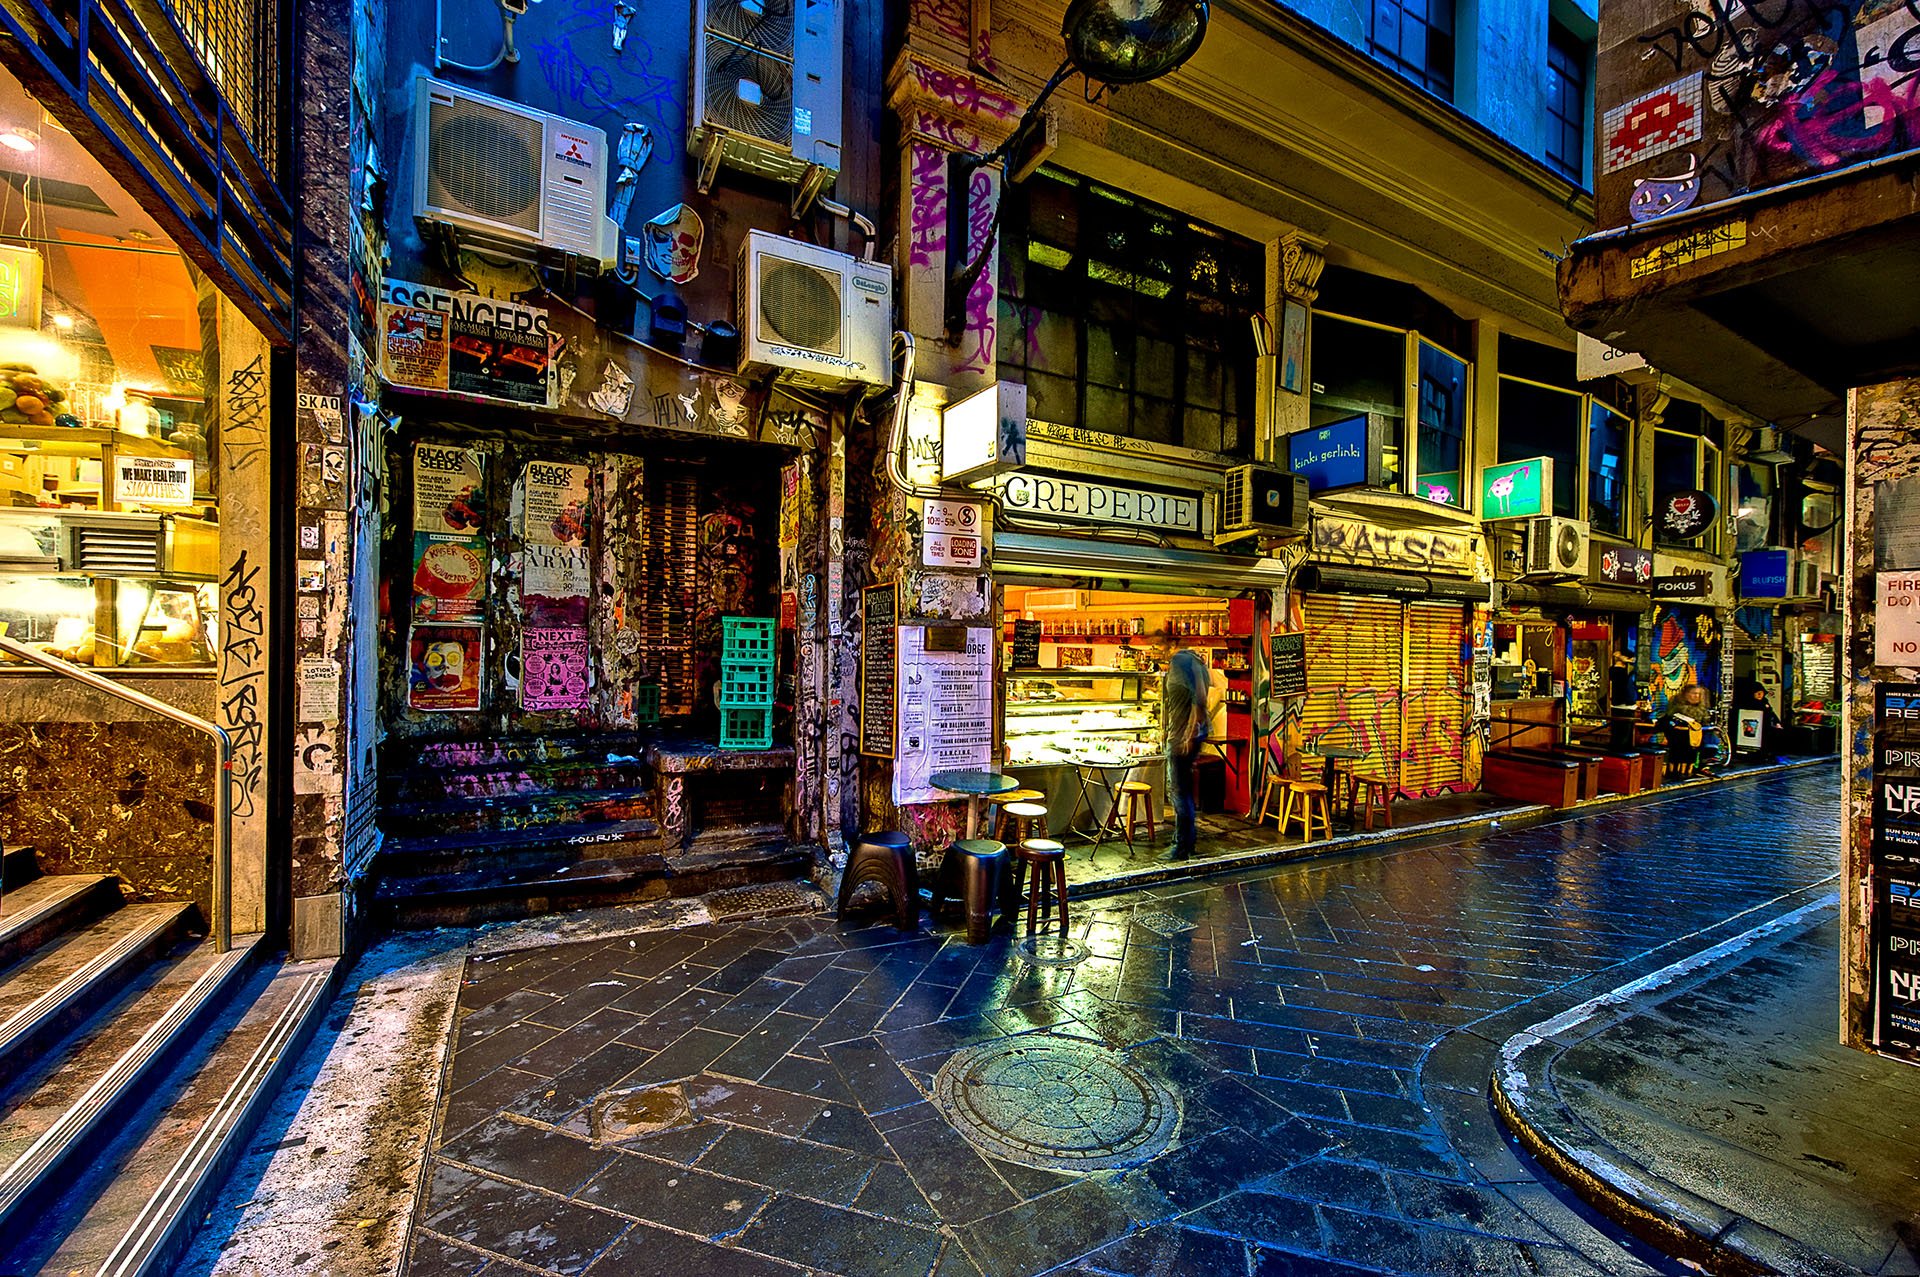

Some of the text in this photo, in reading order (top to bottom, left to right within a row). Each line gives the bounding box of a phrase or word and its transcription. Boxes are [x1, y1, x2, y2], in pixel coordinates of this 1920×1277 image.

[560, 133, 589, 146] INVERTER
[417, 447, 466, 463] BLACK
[1321, 443, 1360, 463] gerlinki
[420, 457, 463, 472] SEEDS
[530, 464, 573, 479] BLACK
[121, 467, 186, 483] WE MAKE REAL FRUIT
[532, 474, 570, 487] SEEDS
[122, 480, 185, 499] SMOOTHIES
[1005, 476, 1192, 527] CREPERIE
[929, 505, 934, 514] 7
[943, 507, 948, 515] 9
[429, 547, 458, 559] KAISER
[525, 544, 589, 560] SUGAR
[951, 540, 976, 557] LOADING ZONE
[526, 554, 588, 570] ARMY
[1657, 581, 1697, 591] FOKUS
[1887, 595, 1911, 607] DO
[538, 631, 574, 641] NEXT
[967, 643, 986, 655] ORGE
[1893, 641, 1917, 653] NO
[1895, 837, 1919, 845] KILDA
